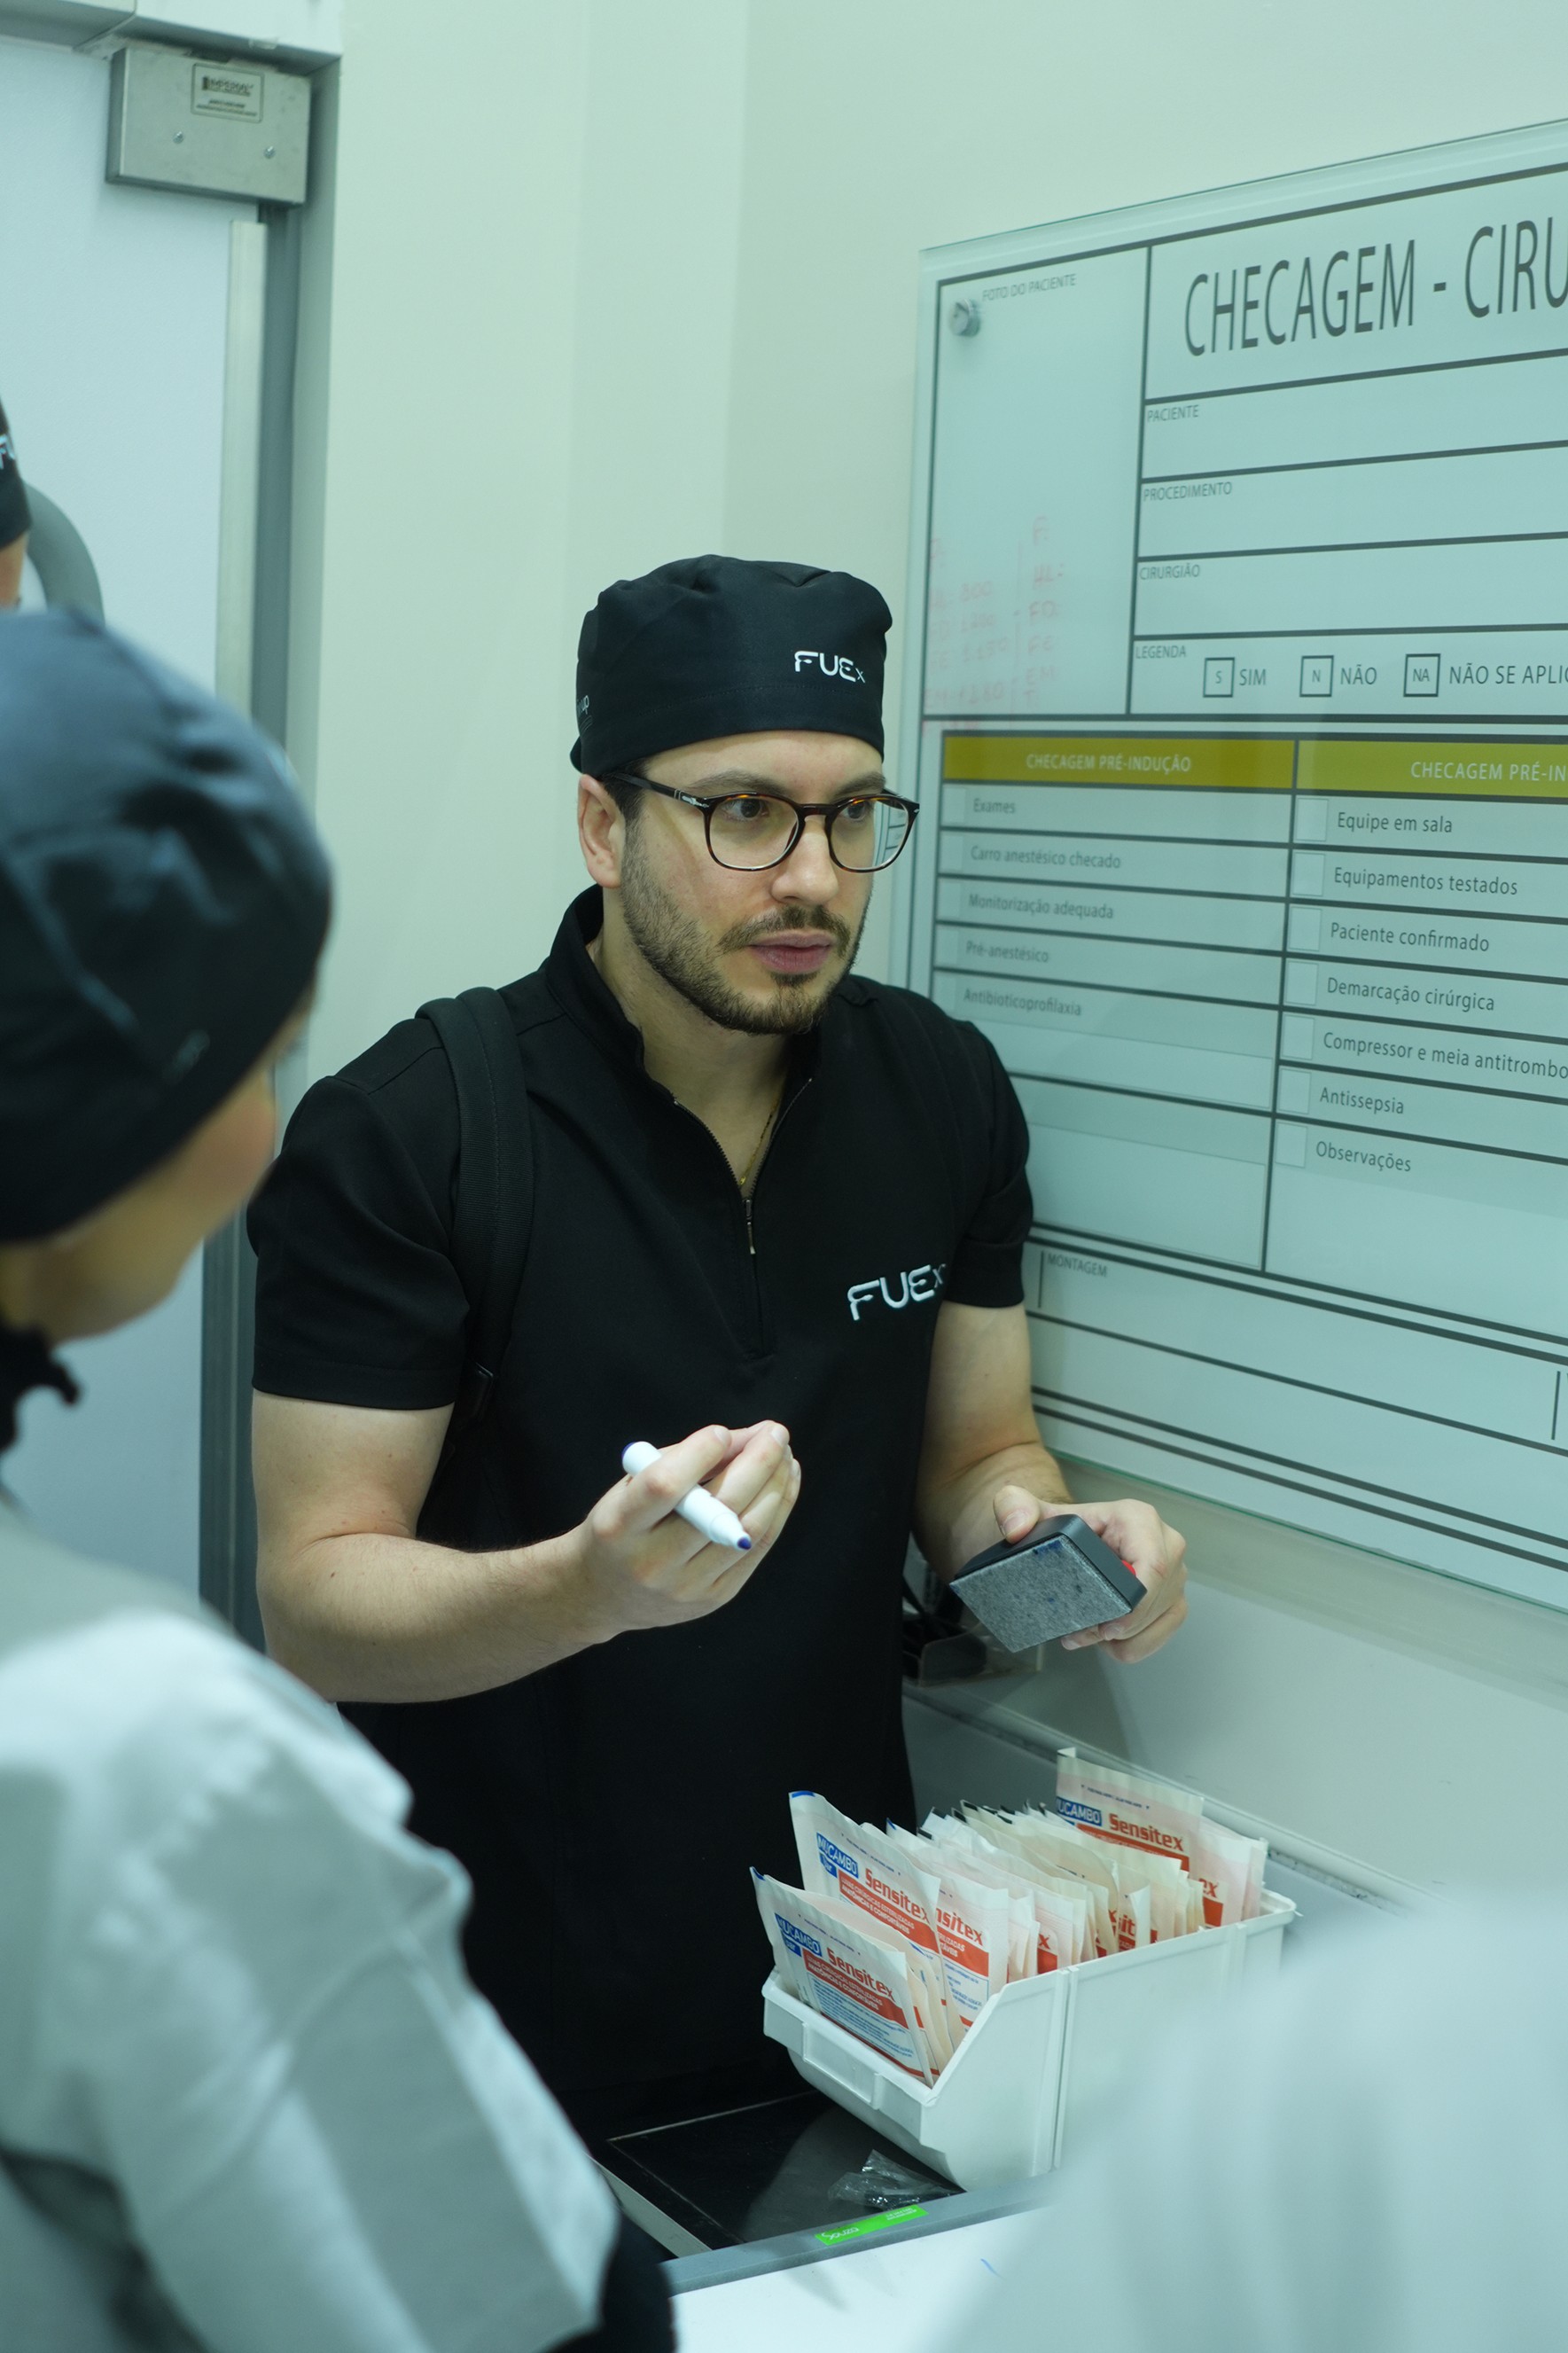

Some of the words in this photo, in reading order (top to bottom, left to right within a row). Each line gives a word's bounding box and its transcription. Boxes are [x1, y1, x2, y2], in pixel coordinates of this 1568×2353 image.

[981, 286, 1010, 301] FOTO
[1010, 283, 1026, 297] DO
[1028, 273, 1077, 293] PACIENTE
[1184, 238, 1416, 357] CHECAGEM
[1464, 216, 1568, 318] CIRU
[1147, 404, 1199, 422] PACIENTE
[1143, 481, 1233, 501] PROCEDIMENTO
[1139, 562, 1201, 580] CIRURGIÃO
[1135, 645, 1187, 659] LEGENDA
[1215, 670, 1222, 684] S
[1238, 668, 1267, 686] SIM
[1312, 669, 1322, 684] N
[1339, 664, 1377, 685] NÃO
[1412, 668, 1430, 682] NA
[1449, 663, 1489, 684] NÃO
[1494, 665, 1517, 684] SE
[1026, 754, 1096, 770] CHECAGEM
[1098, 754, 1192, 775] PRÉ-INDUÇÃO
[1410, 761, 1503, 781] CHECAGEM
[973, 798, 1017, 815] Exames
[1337, 811, 1389, 833] Equipe
[1393, 817, 1417, 831] em
[1422, 816, 1453, 833] sala
[971, 845, 1002, 862] Carro
[1003, 848, 1066, 865] anestésico
[1069, 851, 1122, 870] checado
[1334, 866, 1444, 889] Equipamentos
[1449, 876, 1518, 895] testados
[969, 893, 1050, 917] Monitorização
[1053, 901, 1114, 920] adequada
[1330, 922, 1395, 943] Paciente
[1399, 929, 1490, 951] confirmado
[966, 940, 1049, 963] Pré-anestésico
[963, 989, 1082, 1017] Antibioticoprofilaxia
[1327, 977, 1420, 1005] Demarcação
[1425, 989, 1495, 1012] cirúrgica
[1322, 1032, 1413, 1059] Compressor
[1417, 1047, 1427, 1060] e
[1431, 1048, 1470, 1067] meia
[1474, 1053, 1568, 1079] antitrombo
[1319, 1087, 1405, 1115] Antissepsia
[1315, 1140, 1412, 1172] Observações
[1047, 1252, 1108, 1278] MONTAGEM
[1109, 1812, 1185, 1852] Sensitex
[865, 1868, 931, 1925] Sensitex
[936, 1907, 984, 1946] nsitex
[827, 1946, 896, 2003] Sensitex
